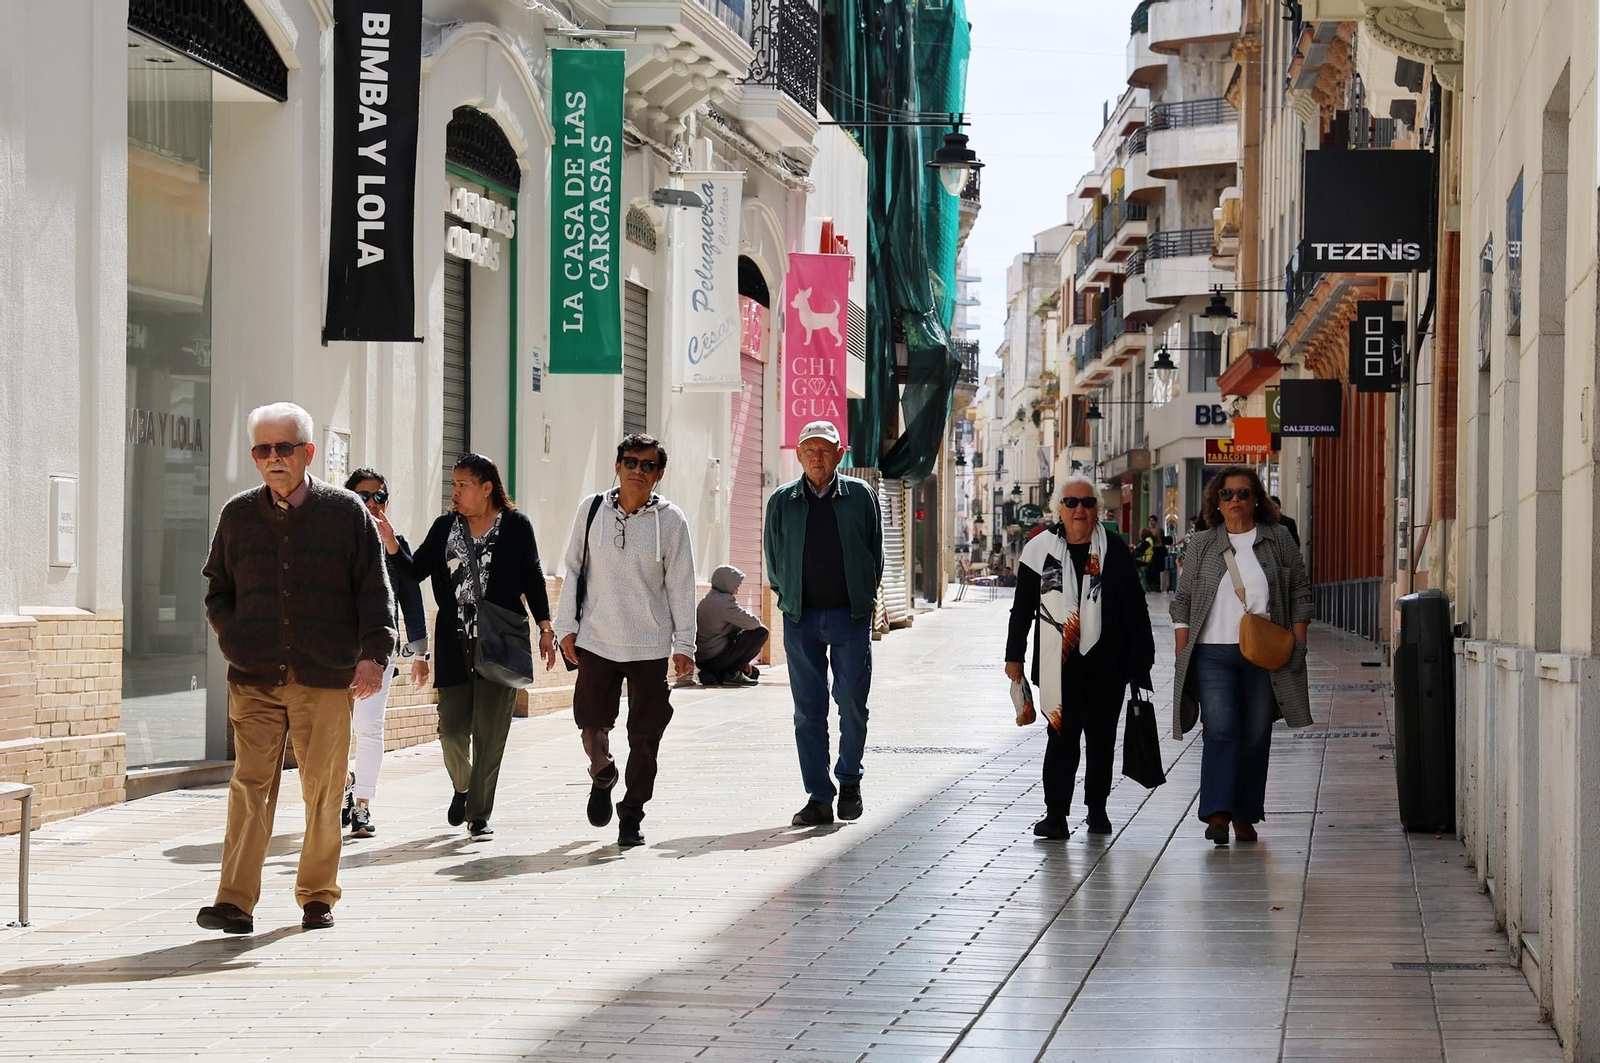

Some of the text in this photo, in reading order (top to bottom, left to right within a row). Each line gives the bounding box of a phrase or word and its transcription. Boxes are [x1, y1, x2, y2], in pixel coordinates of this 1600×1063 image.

[356, 12, 391, 268] BIMBA Y LOLA
[562, 91, 587, 333] LA CASA DE LAS
[589, 135, 612, 290] CARCASAS
[792, 357, 836, 376] CHI
[791, 398, 840, 417] GUA
[1195, 404, 1227, 425] BB
[157, 412, 168, 447] Y
[169, 415, 203, 452] LOLA
[1207, 453, 1246, 461] TABACOS
[1236, 444, 1268, 453] orange
